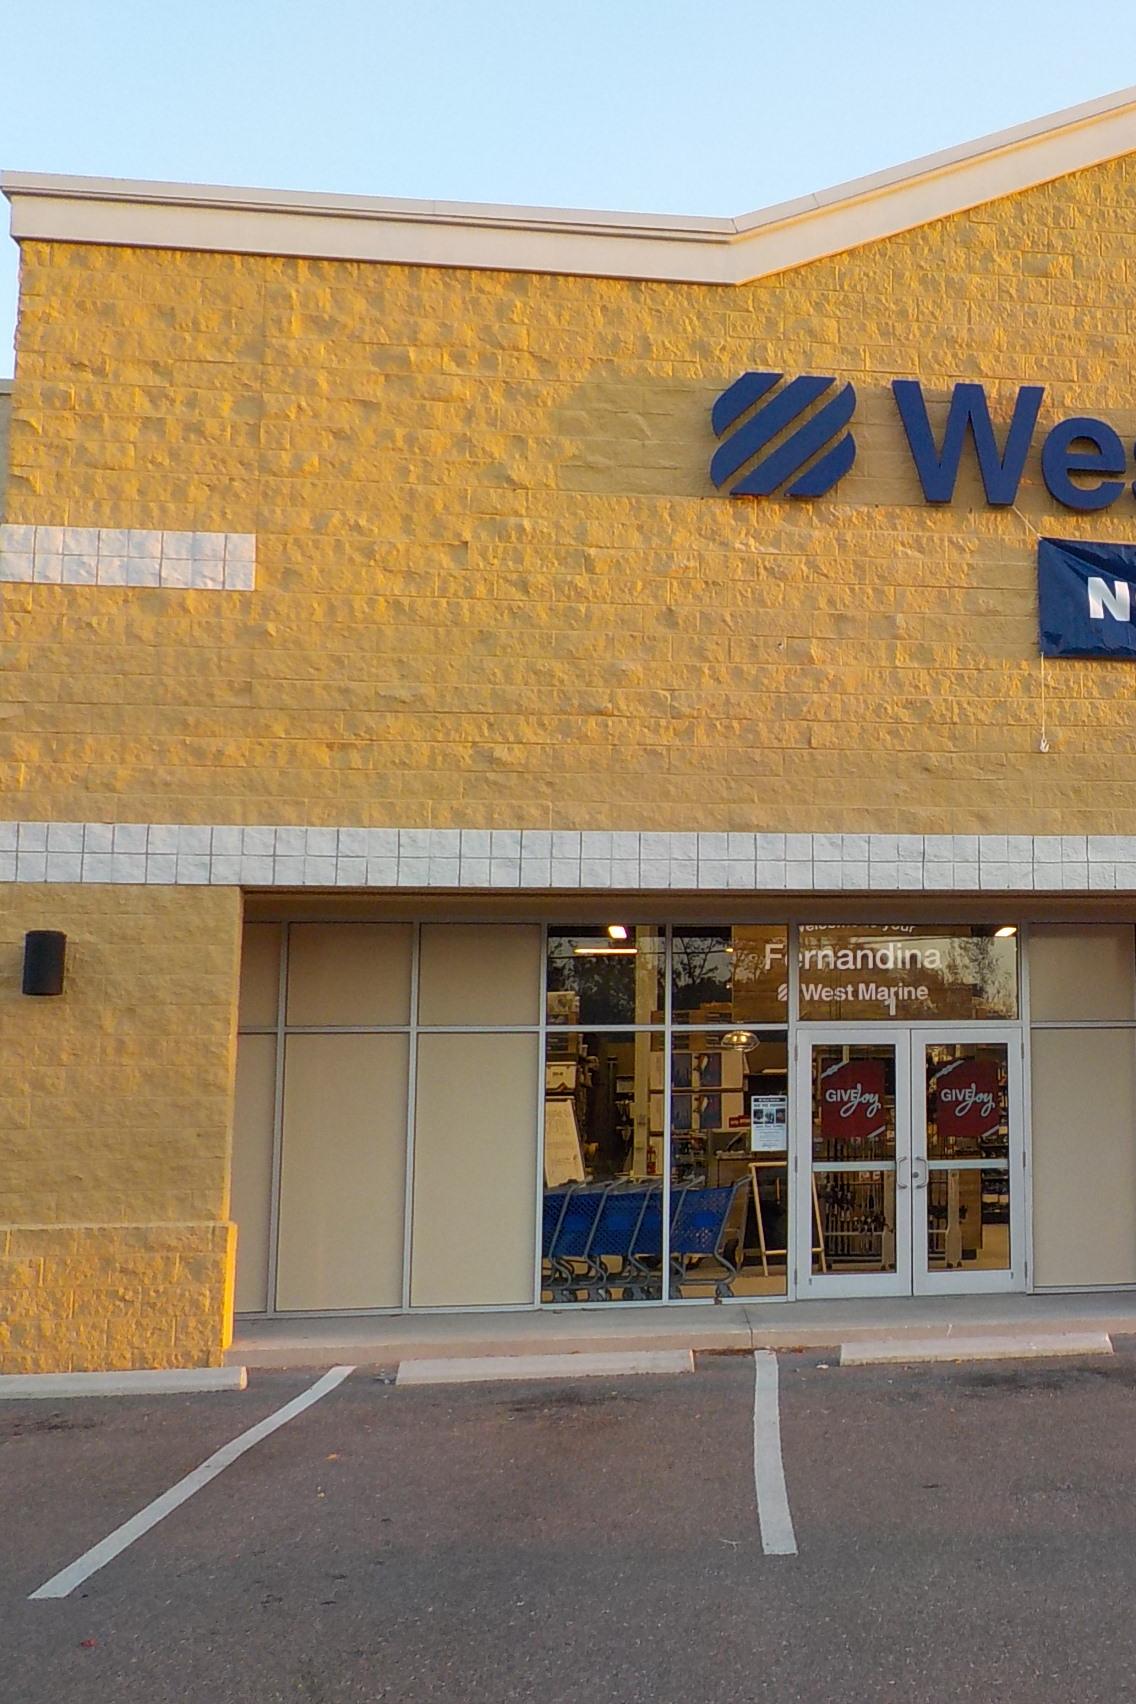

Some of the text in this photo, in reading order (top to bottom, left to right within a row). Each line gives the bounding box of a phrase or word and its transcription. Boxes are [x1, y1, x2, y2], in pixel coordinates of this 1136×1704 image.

[801, 983, 929, 1001] West Marine
[825, 1089, 858, 1102] GIVE
[940, 1088, 973, 1102] GIVE
